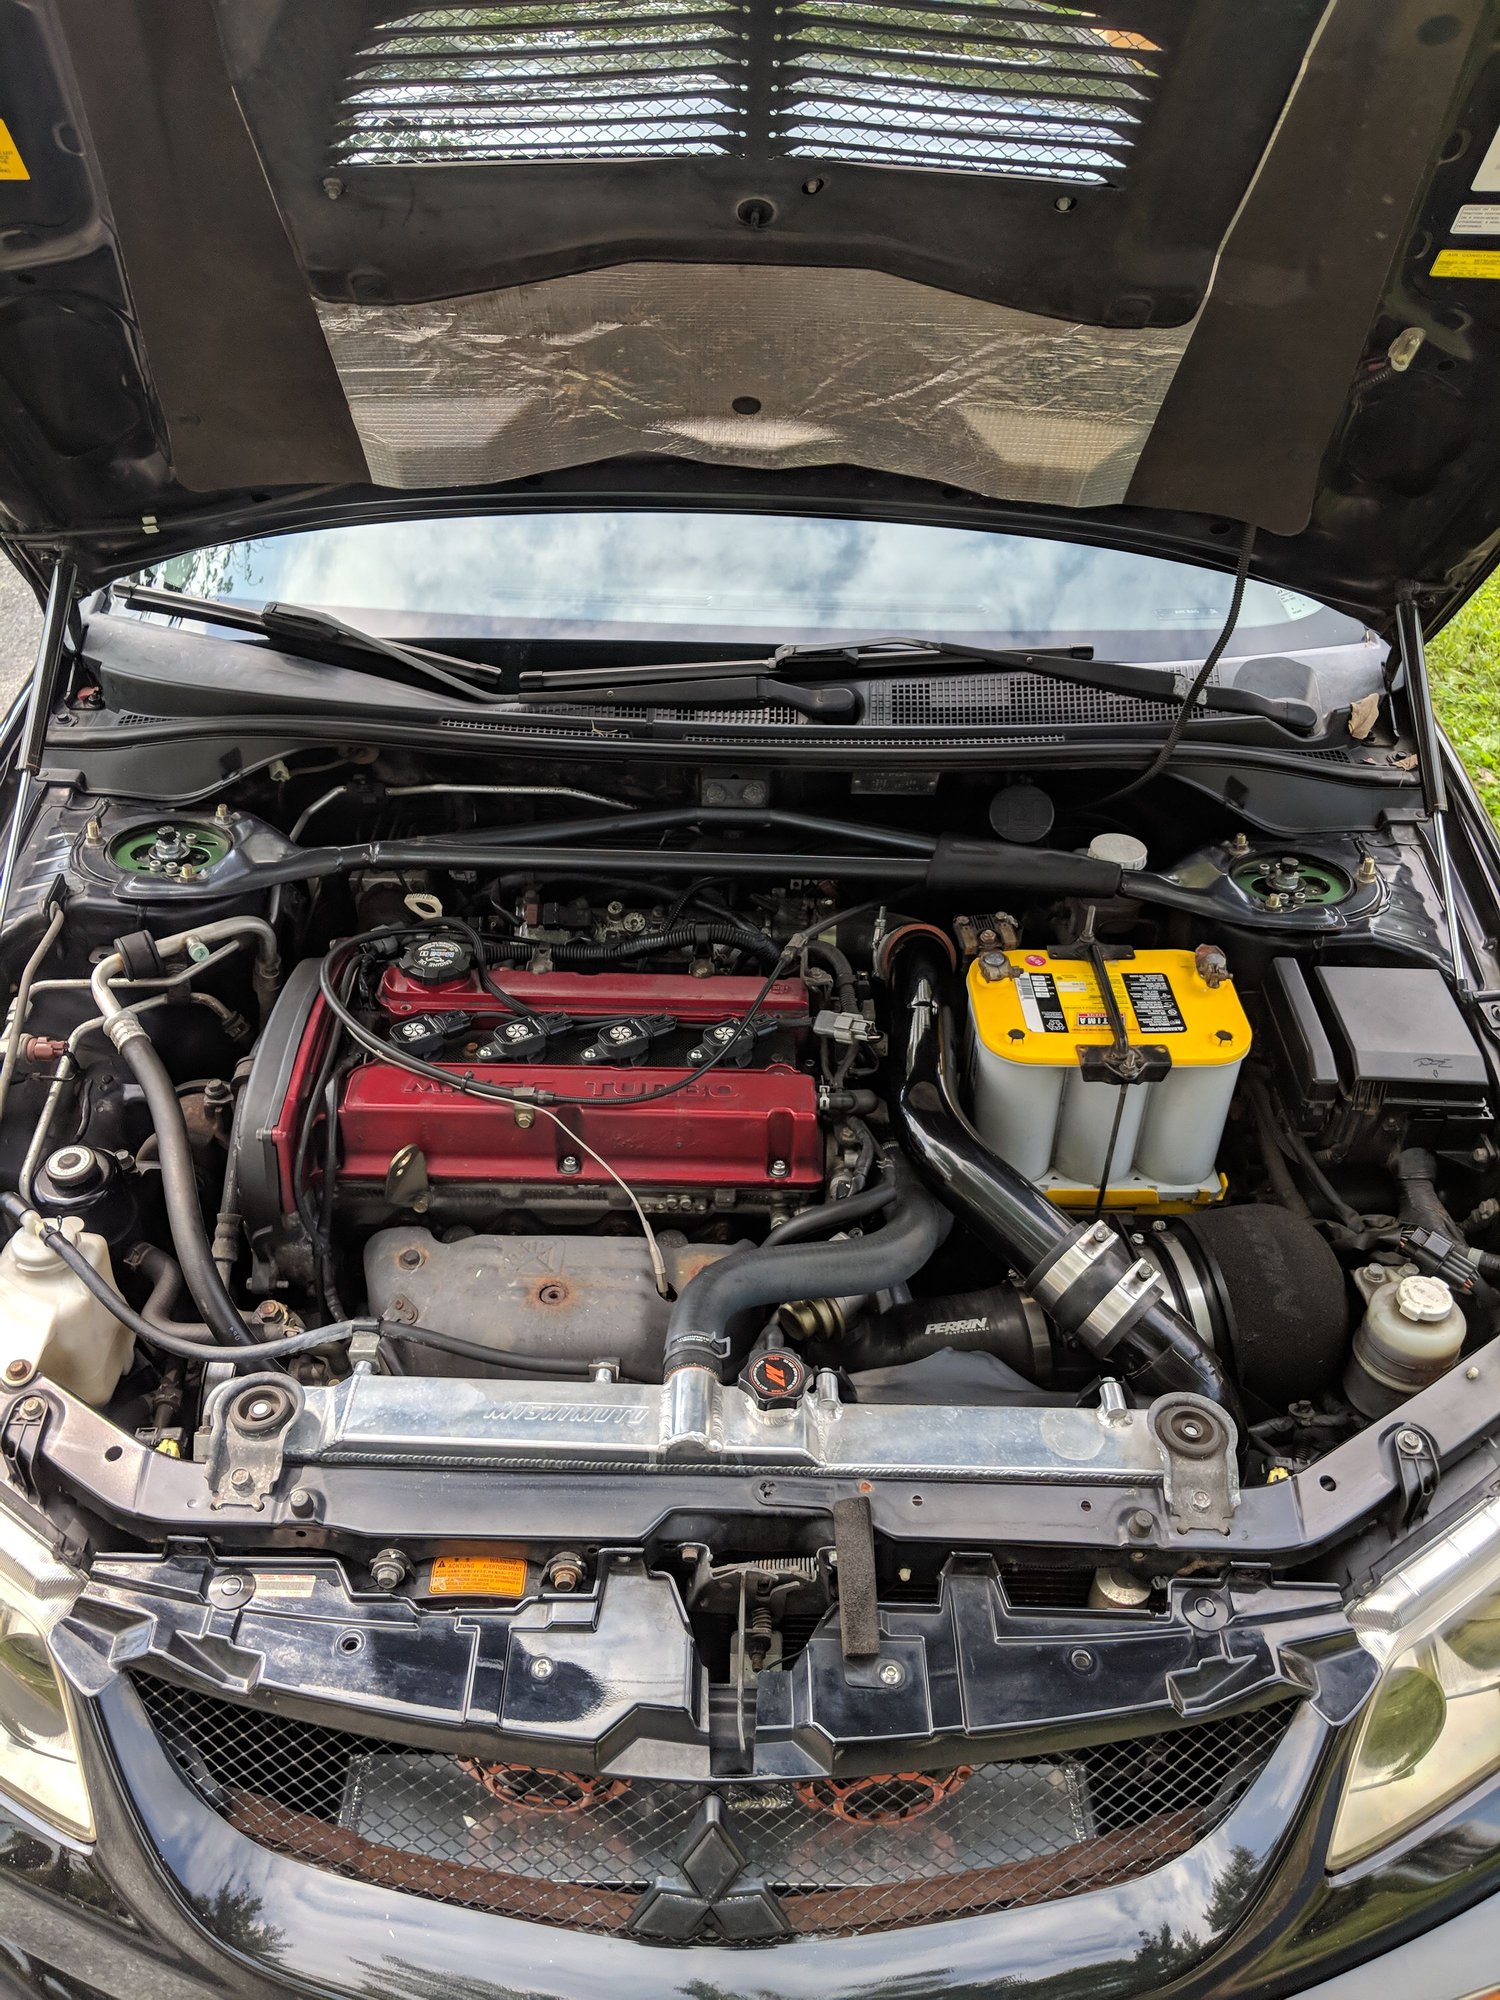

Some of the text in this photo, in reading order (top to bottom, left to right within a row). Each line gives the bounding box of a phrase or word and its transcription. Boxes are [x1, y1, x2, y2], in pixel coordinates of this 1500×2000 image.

[428, 959, 453, 967] ENGINE
[1080, 1017, 1114, 1025] TIMA
[924, 1317, 988, 1335] PERRIN
[483, 1400, 650, 1424] MISHIMOTO
